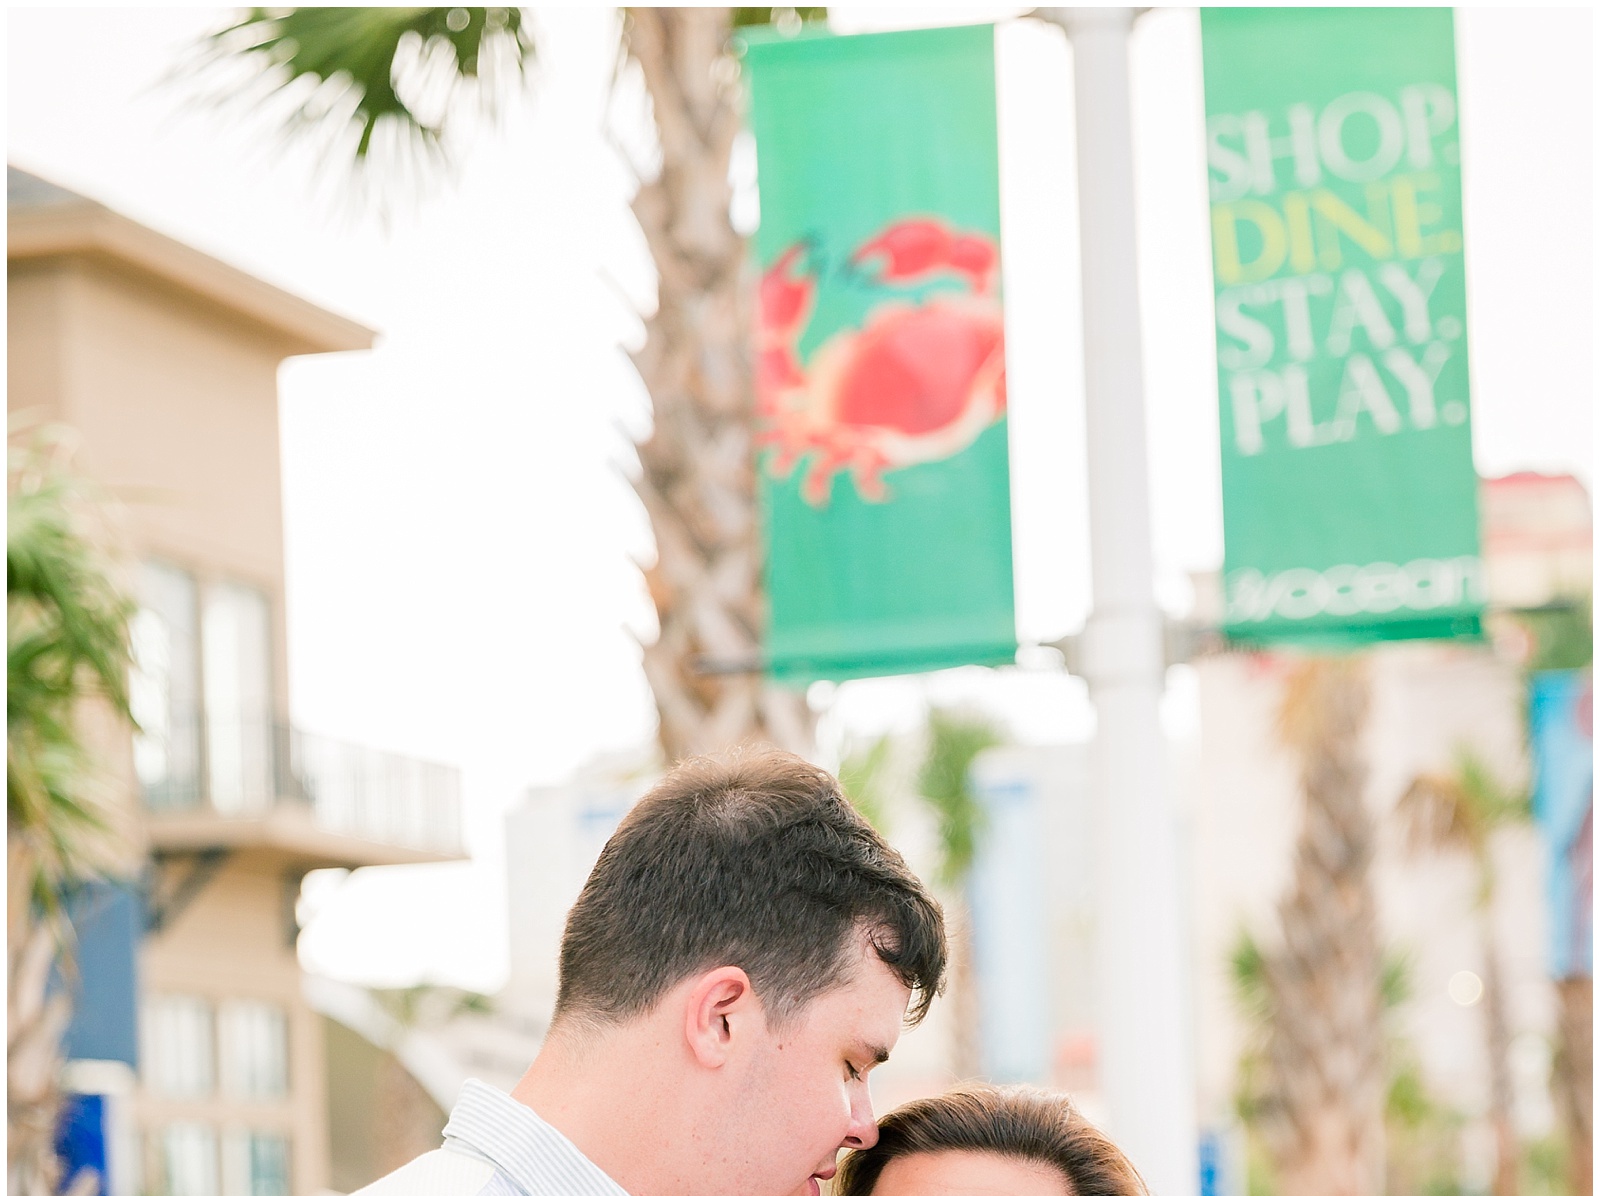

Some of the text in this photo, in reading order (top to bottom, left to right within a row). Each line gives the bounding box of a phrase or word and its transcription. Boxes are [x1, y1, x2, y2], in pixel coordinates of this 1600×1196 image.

[1206, 82, 1461, 203] SHOP.
[1211, 171, 1463, 285] DINE.
[1215, 257, 1463, 372] STAY.
[1228, 339, 1468, 455] PLAY.
